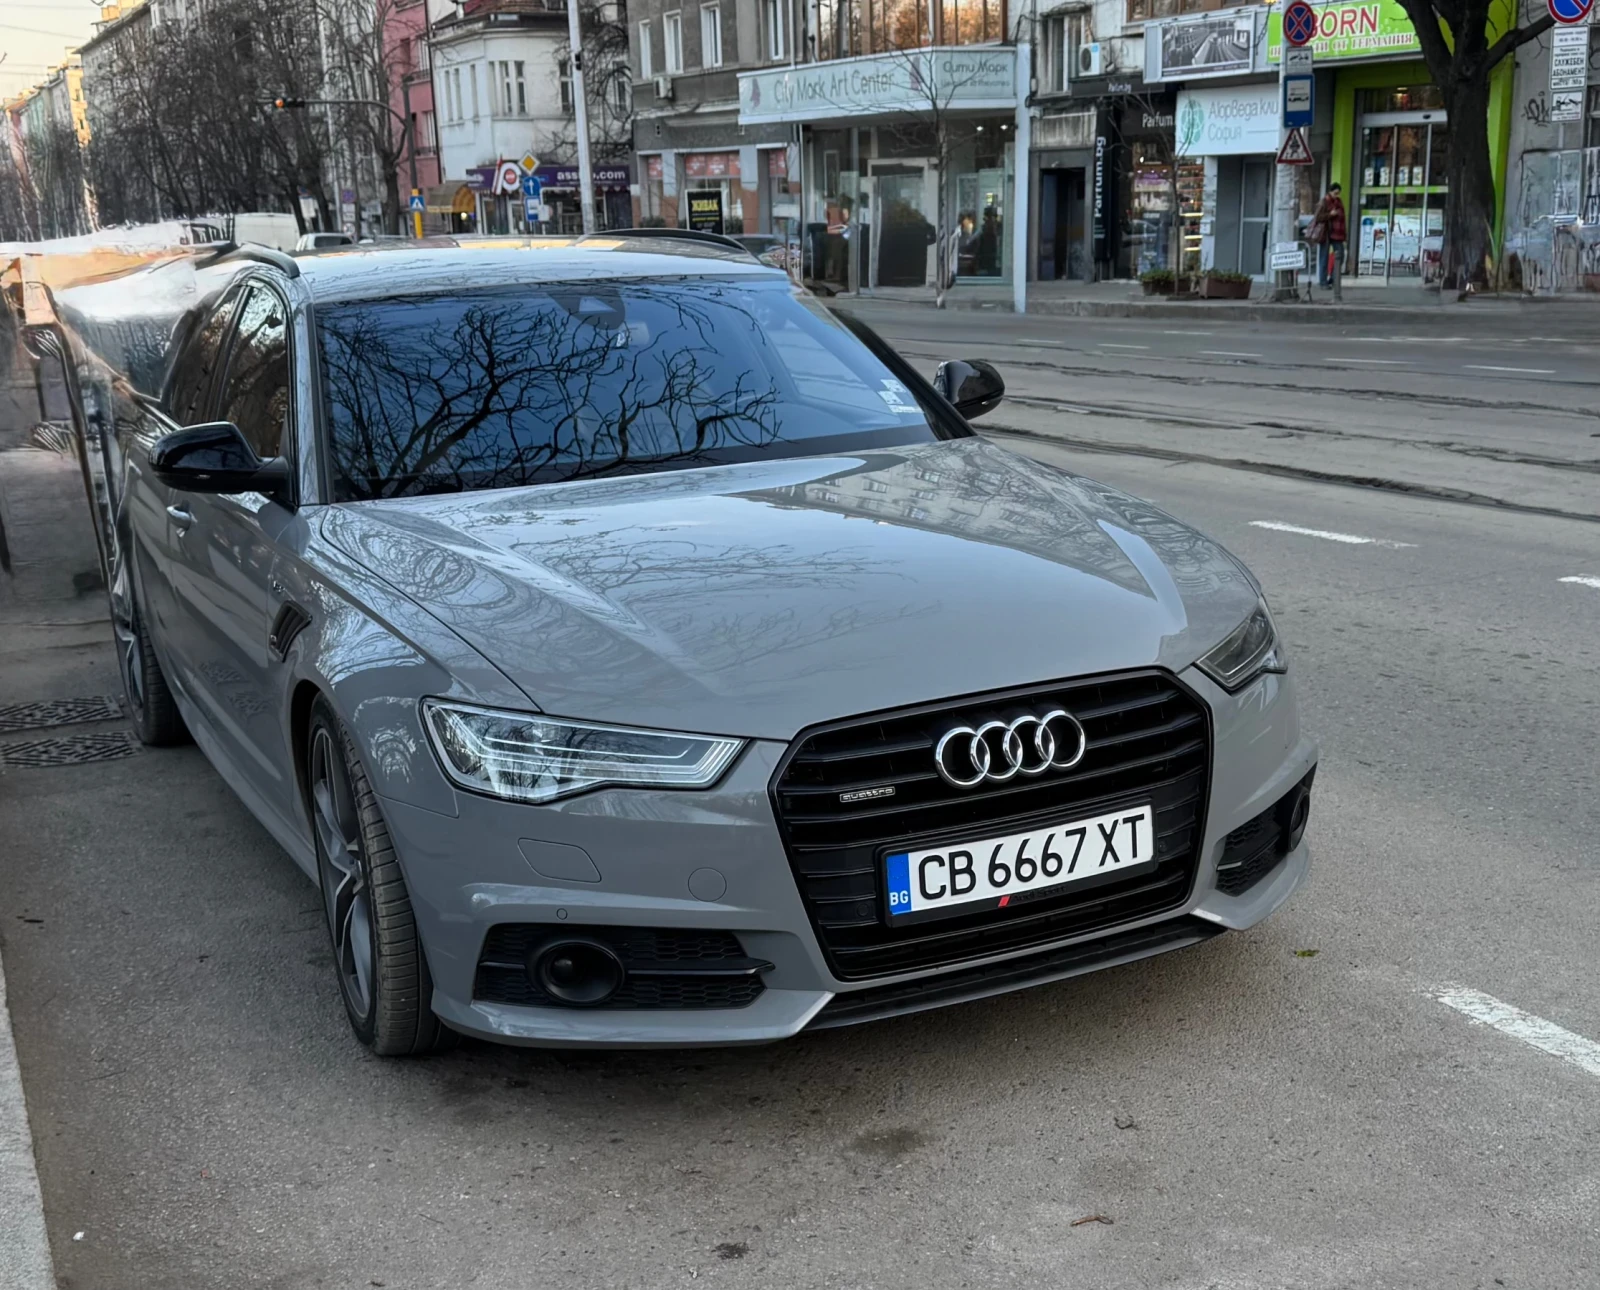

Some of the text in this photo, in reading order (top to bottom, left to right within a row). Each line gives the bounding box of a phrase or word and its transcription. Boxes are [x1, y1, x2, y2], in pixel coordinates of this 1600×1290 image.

[1352, 33, 1414, 49] ГЕРМАНИЯ
[979, 59, 1008, 75] Марк
[774, 77, 794, 108] City
[830, 71, 848, 97] Art
[852, 67, 895, 95] Center
[1208, 123, 1242, 145] София
[1094, 136, 1106, 218] Parfum.bg
[842, 788, 893, 800] quattro
[918, 813, 1145, 900] CB 6667 XT
[889, 890, 909, 906] BG
